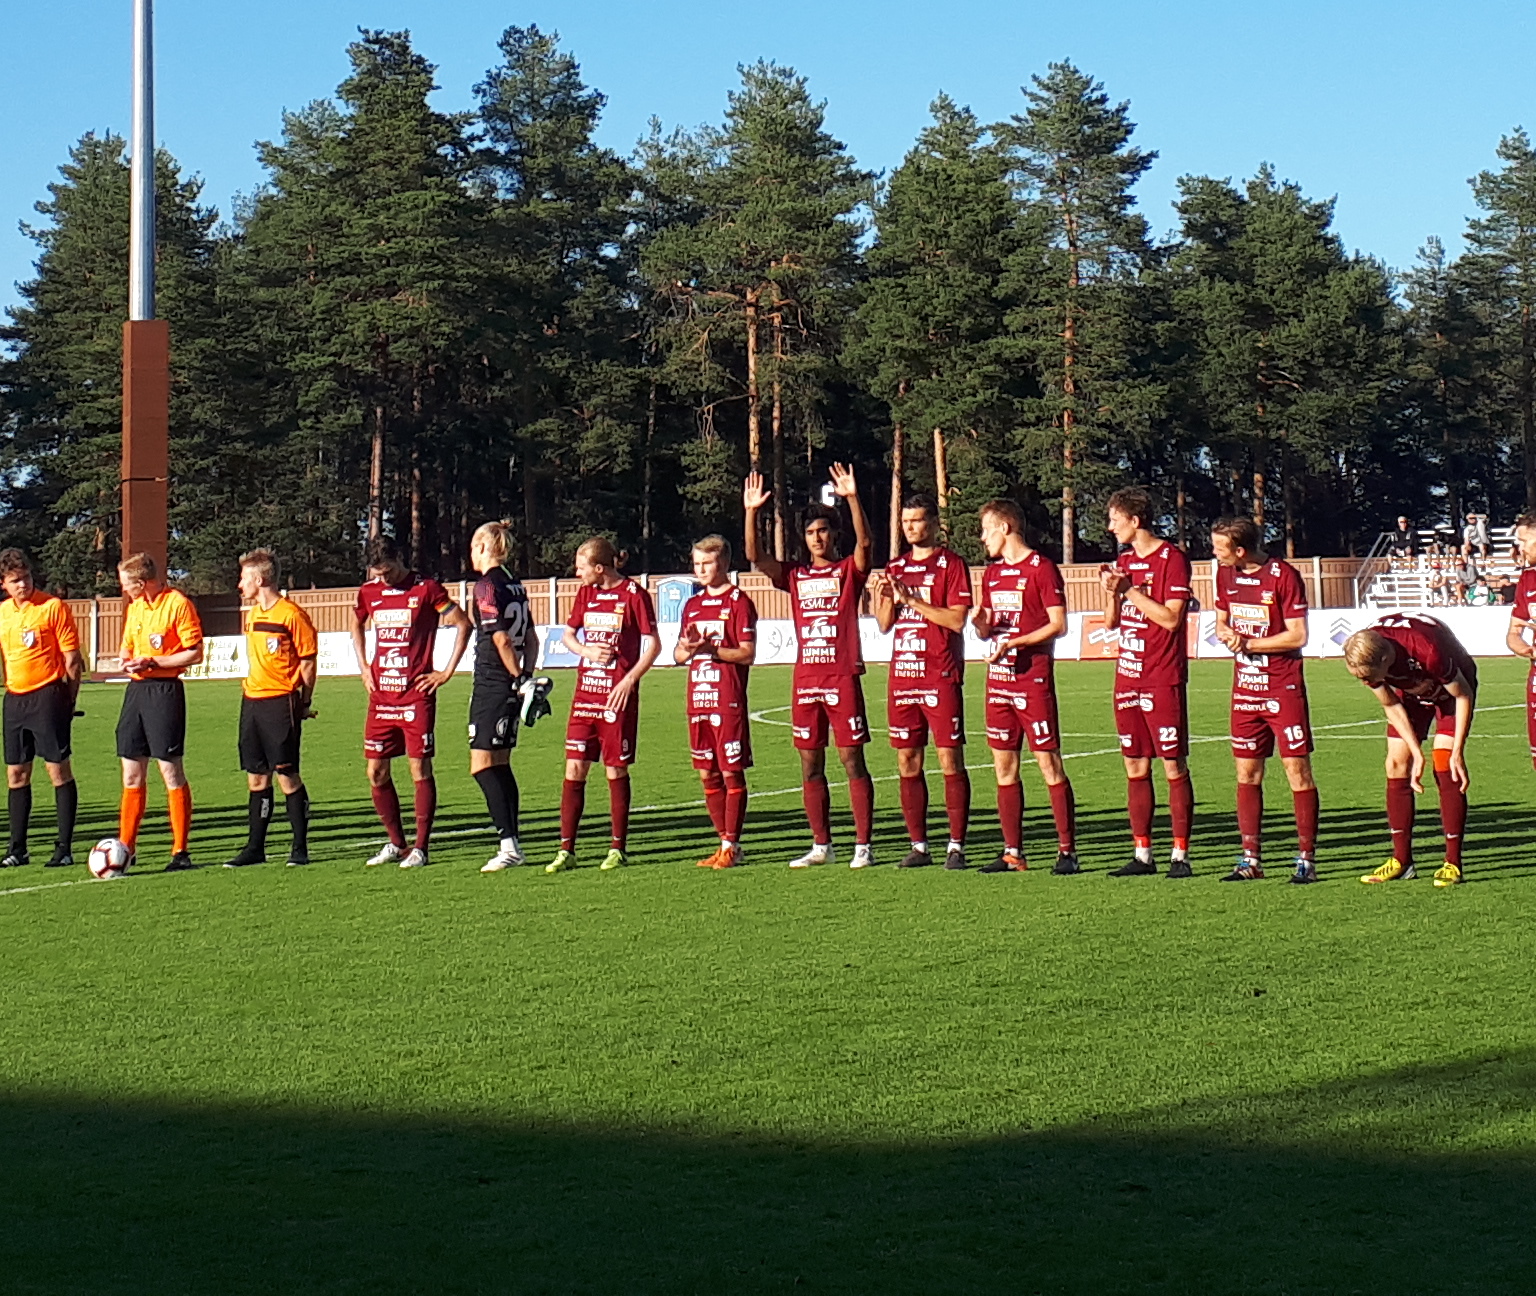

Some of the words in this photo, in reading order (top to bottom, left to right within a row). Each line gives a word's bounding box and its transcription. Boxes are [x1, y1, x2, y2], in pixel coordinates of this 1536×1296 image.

[848, 716, 863, 731] 12
[1032, 721, 1049, 736] 11
[1159, 727, 1178, 742] 22
[1284, 725, 1304, 741] 16
[724, 741, 741, 757] 25
